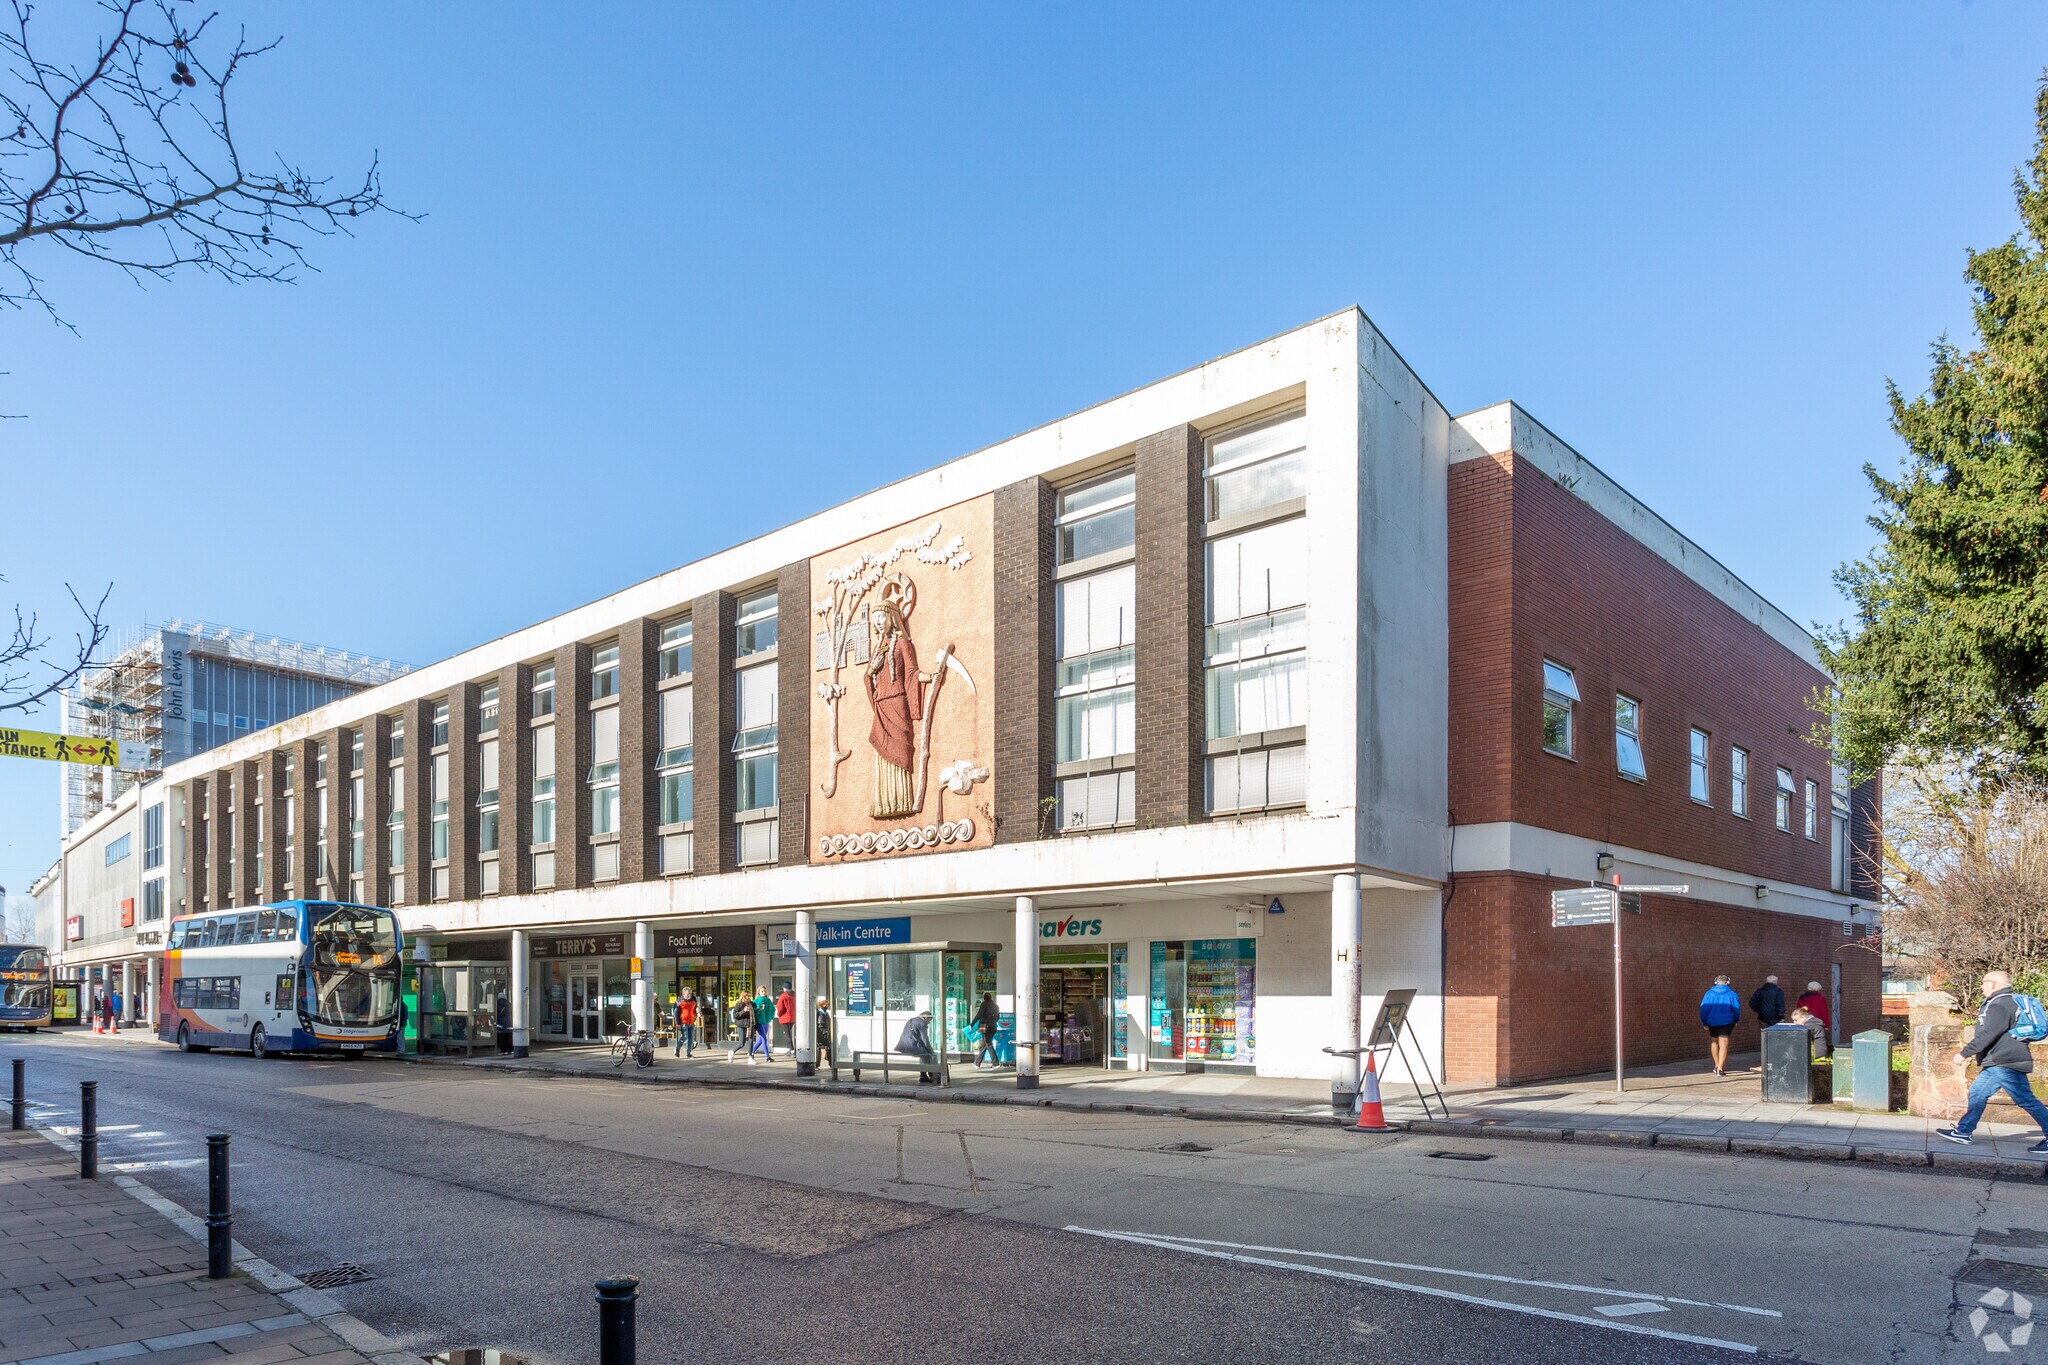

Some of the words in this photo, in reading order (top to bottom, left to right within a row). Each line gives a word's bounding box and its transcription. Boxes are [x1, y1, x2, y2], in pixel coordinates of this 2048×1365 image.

[166, 649, 183, 687] Lewis
[167, 690, 187, 722] John
[0, 743, 46, 758] TANCE
[668, 935, 688, 947] Foot
[689, 933, 713, 946] Clinic
[854, 925, 892, 940] Centre
[555, 938, 597, 955] TERRY'S
[729, 981, 752, 992] EVER
